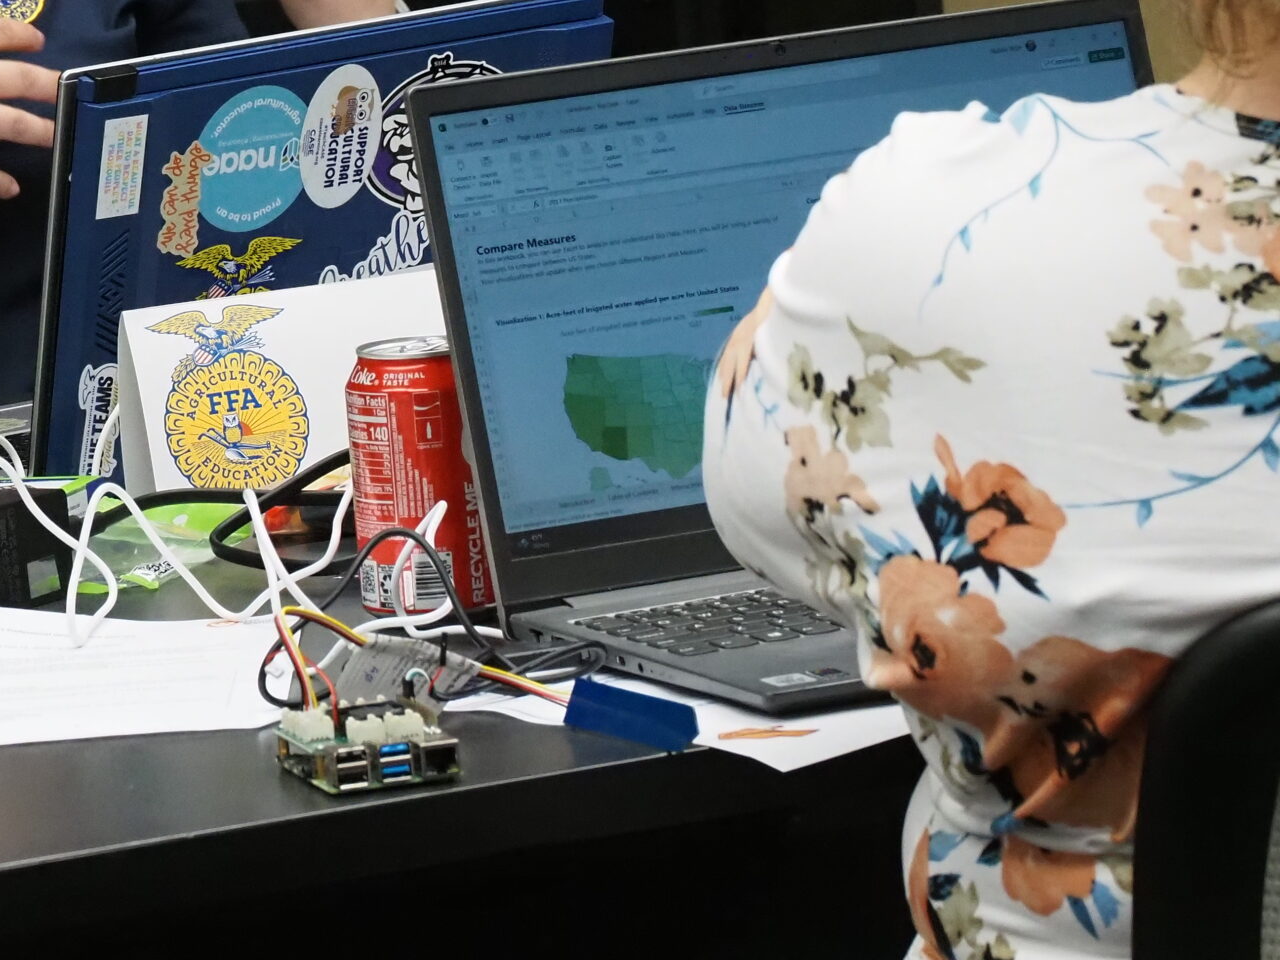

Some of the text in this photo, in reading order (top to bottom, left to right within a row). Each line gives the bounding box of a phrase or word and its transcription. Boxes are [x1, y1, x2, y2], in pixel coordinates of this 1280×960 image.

[254, 98, 301, 126] agricultural
[307, 129, 317, 155] CASE
[352, 125, 369, 184] SUPPORT
[165, 155, 186, 177] do
[202, 144, 277, 177] naae
[127, 159, 140, 210] BEAUTIFUL
[175, 143, 212, 254] hard things
[216, 206, 228, 219] an
[228, 211, 240, 223] be
[241, 211, 251, 222] to
[476, 234, 577, 257] Compare Measures
[496, 315, 537, 327] Visualization
[546, 309, 576, 320] Acre-feet
[577, 307, 585, 315] of
[615, 301, 632, 309] water
[634, 295, 657, 307] applied
[659, 295, 669, 304] per
[671, 292, 684, 301] acre
[686, 291, 696, 299] for
[697, 287, 718, 297] United
[719, 284, 739, 294] States
[351, 365, 377, 386] Coke
[382, 379, 410, 387] TASTE
[383, 372, 426, 380] ORIGINAL
[91, 376, 114, 435] TEAMS
[186, 370, 282, 421] AGRICULTURAL
[206, 388, 262, 416] FFA
[366, 395, 386, 408] Facts
[369, 426, 388, 441] 140
[201, 444, 284, 480] EDUCATION
[464, 482, 485, 603] RECYCLE ME
